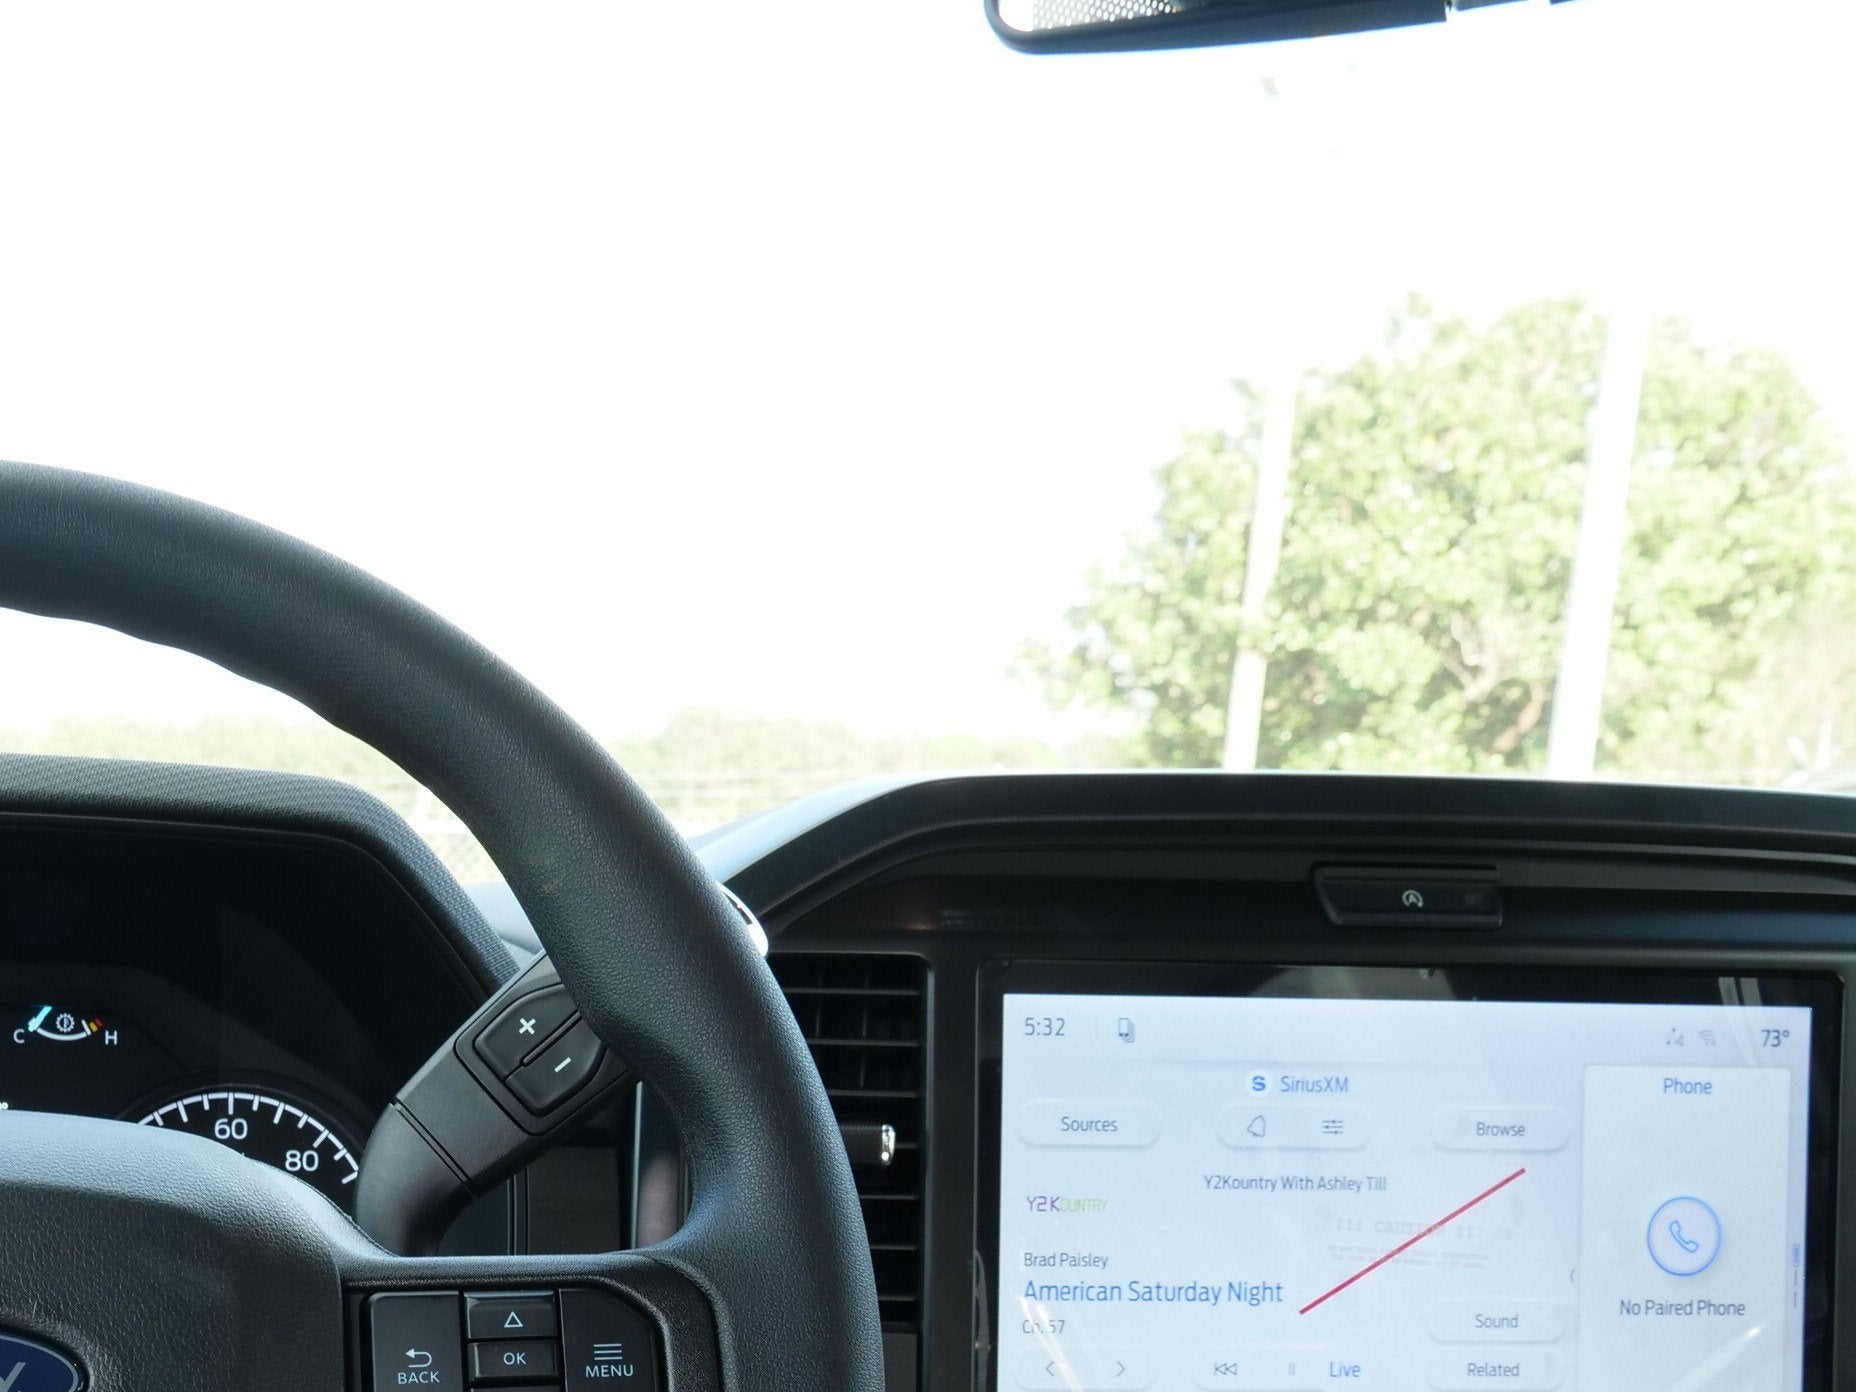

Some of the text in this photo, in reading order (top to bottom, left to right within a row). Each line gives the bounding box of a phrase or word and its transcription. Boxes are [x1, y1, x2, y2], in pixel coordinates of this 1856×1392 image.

[1024, 1017, 1066, 1037] 5:32
[13, 1029, 25, 1044] C
[104, 1030, 118, 1045] H
[1760, 1029, 1791, 1048] 73°
[1280, 1075, 1349, 1094] SiriusXM
[1663, 1077, 1712, 1095] Phone
[214, 1118, 248, 1139] 60
[1061, 1116, 1118, 1133] Sources
[1476, 1121, 1526, 1137] Browse
[284, 1150, 319, 1171] 80
[1204, 1174, 1277, 1192] Y2Kountry
[1280, 1175, 1314, 1190] With
[1317, 1176, 1362, 1193] Ashley
[1023, 1252, 1108, 1269] Brad Paisley
[1024, 1280, 1283, 1306] American Saturday Night
[1619, 1300, 1746, 1317] No Paired Phone
[1048, 1319, 1066, 1334] 57
[1475, 1313, 1519, 1329] Sound
[503, 1352, 527, 1366] OK
[397, 1371, 440, 1384] BACK
[585, 1364, 634, 1378] MENU
[1329, 1361, 1361, 1378] Live
[1467, 1362, 1520, 1378] Related
